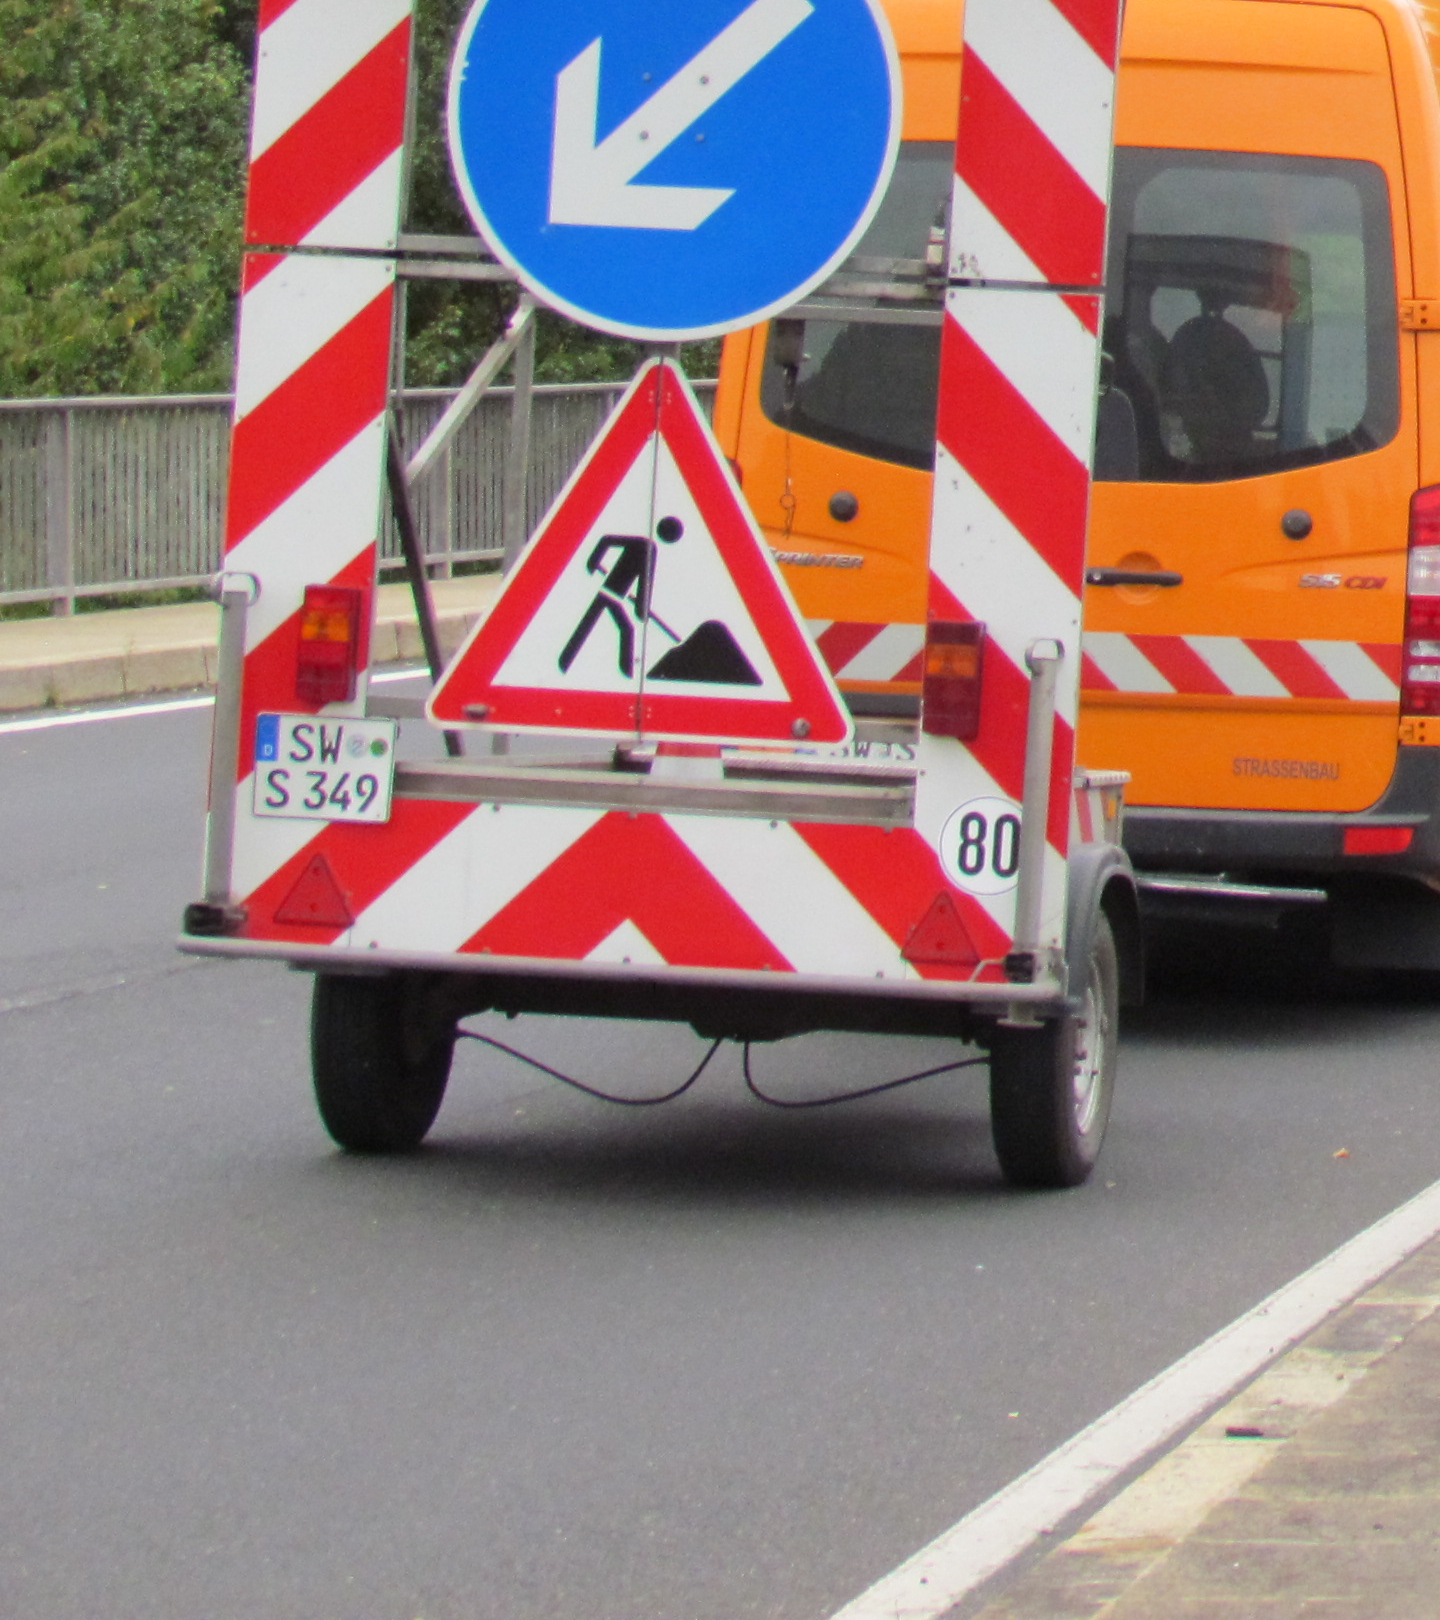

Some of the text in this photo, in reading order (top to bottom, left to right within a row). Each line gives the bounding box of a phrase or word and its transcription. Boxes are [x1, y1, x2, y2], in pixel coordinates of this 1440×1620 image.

[1344, 575, 1389, 589] CDI
[290, 723, 344, 764] SW
[1232, 757, 1340, 780] STRASSENBAU
[265, 768, 379, 813] S 349
[958, 811, 1021, 879] 80
